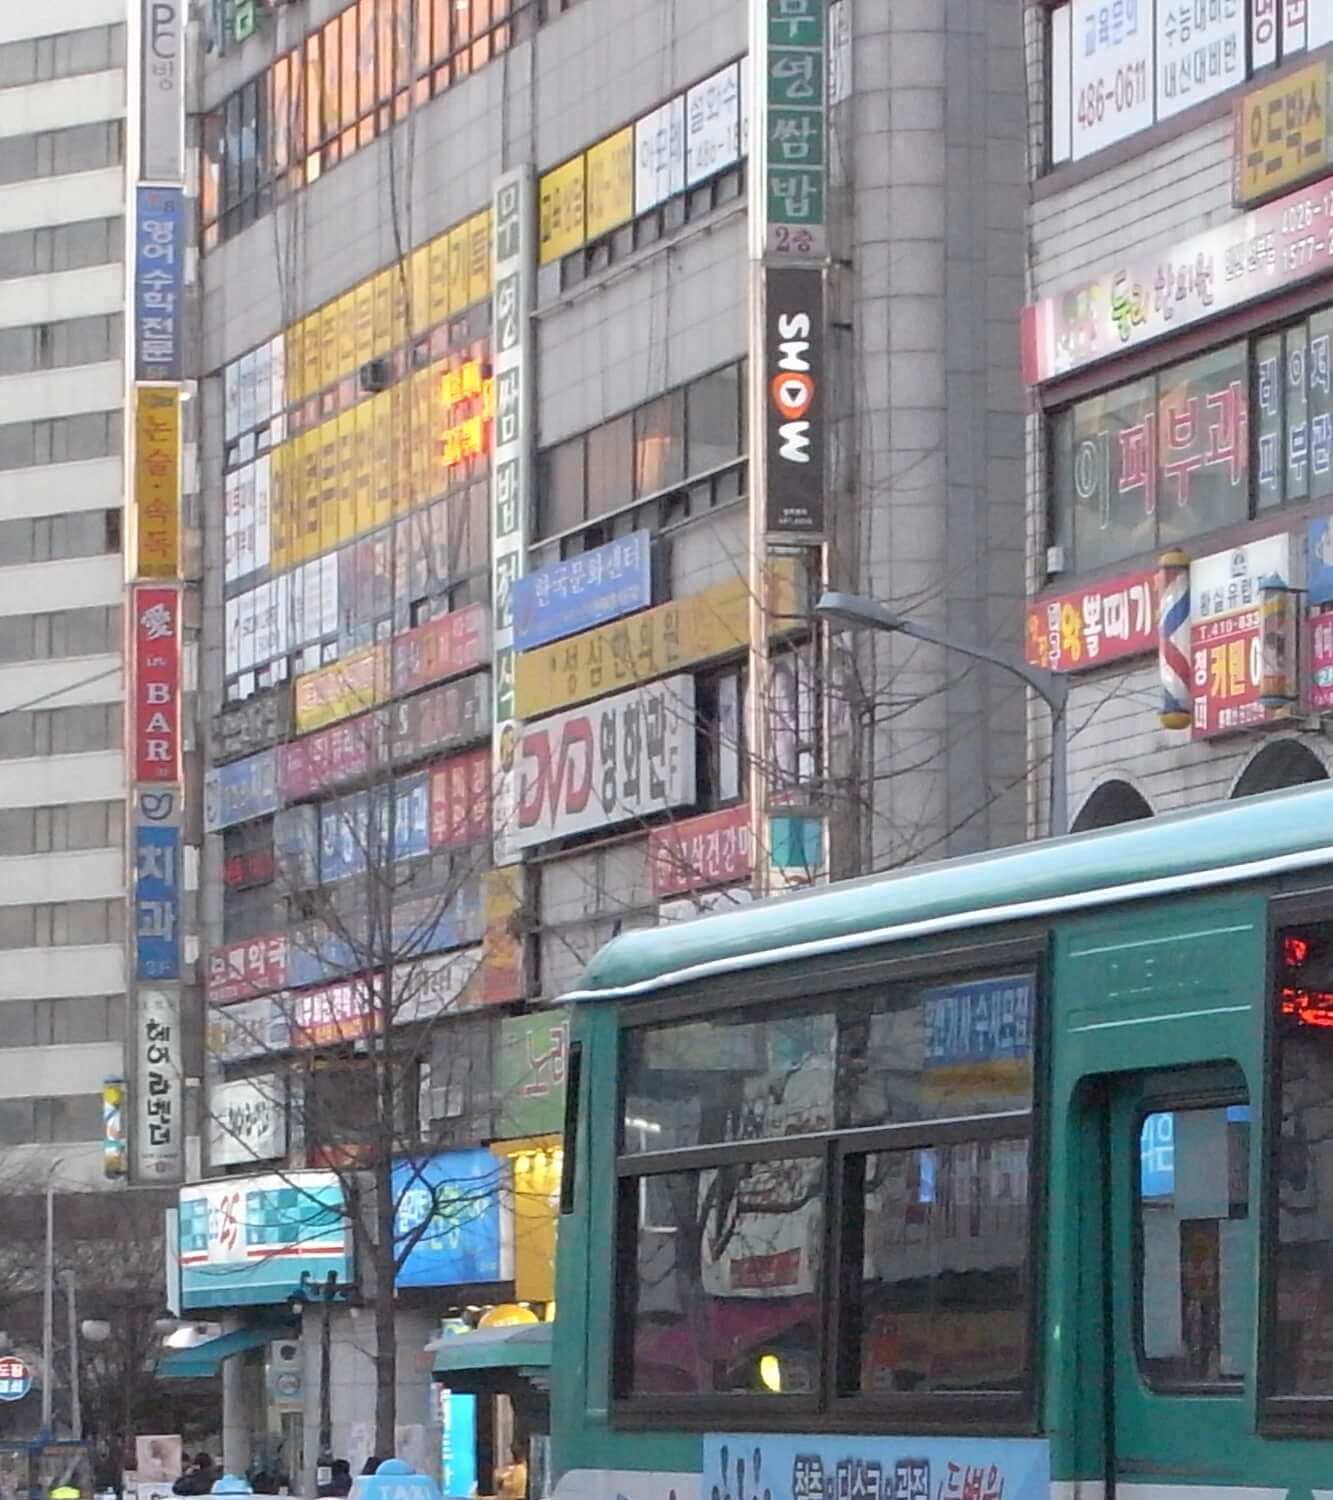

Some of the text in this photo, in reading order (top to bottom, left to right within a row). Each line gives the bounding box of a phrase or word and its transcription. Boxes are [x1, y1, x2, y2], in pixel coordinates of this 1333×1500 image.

[773, 312, 814, 463] SHOW
[145, 682, 172, 762] BAR
[138, 844, 176, 943] 치과
